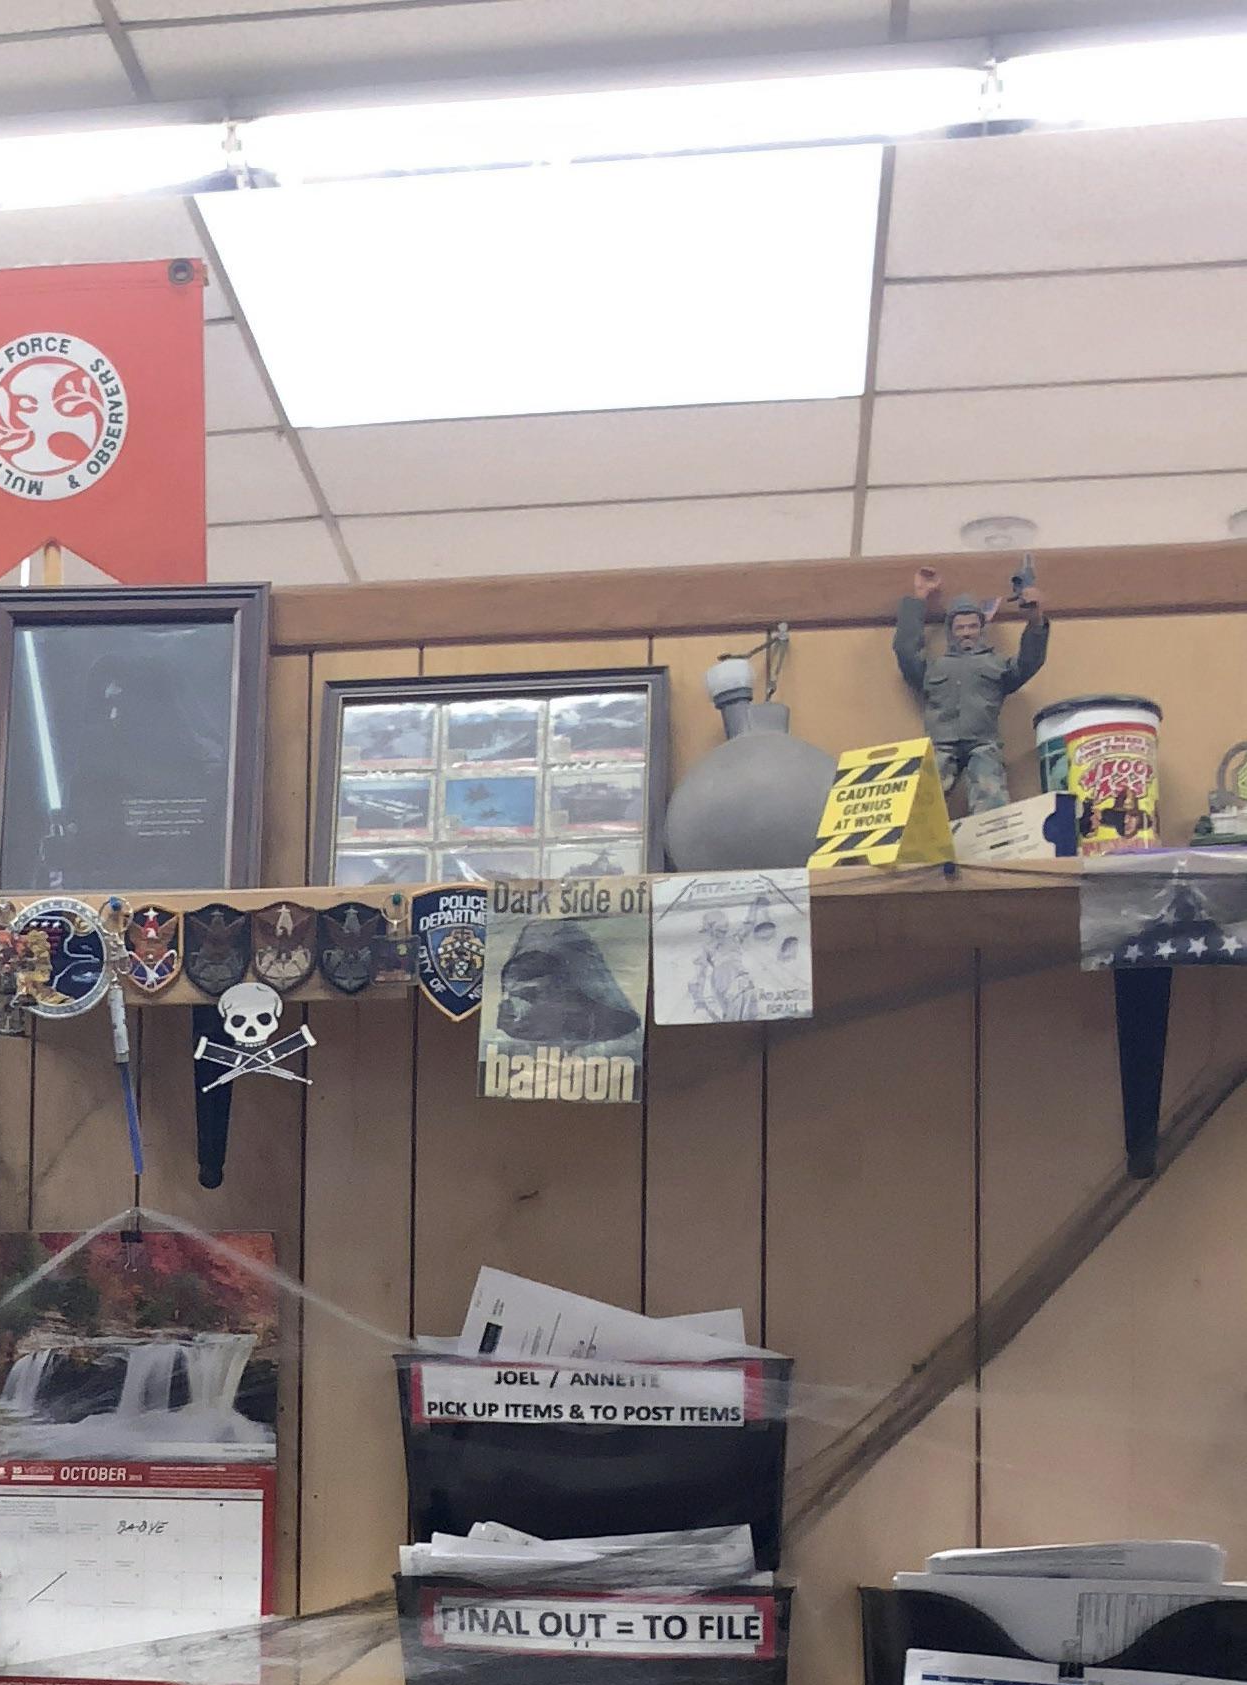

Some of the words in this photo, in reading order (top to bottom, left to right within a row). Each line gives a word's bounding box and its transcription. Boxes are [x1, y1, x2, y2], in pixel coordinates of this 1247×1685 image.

[4, 336, 72, 364] FORCE
[86, 357, 124, 476] OBSERVERS
[836, 780, 908, 802] CAUTION!
[843, 798, 892, 816] GENIUS
[833, 819, 851, 831] AT
[854, 813, 893, 828] WORK
[439, 895, 487, 910] POLICE
[493, 880, 551, 914] Dark
[559, 880, 610, 914] side
[620, 881, 647, 914] of
[419, 909, 487, 931] DEPARTME
[485, 1044, 635, 1101] balloon
[495, 1371, 540, 1386] JOEL
[427, 1401, 467, 1417] PICK
[473, 1402, 499, 1417] UP
[505, 1403, 564, 1420] ITEMS
[569, 1404, 585, 1420] &
[590, 1404, 618, 1420] TO
[623, 1405, 675, 1421] POST
[679, 1406, 742, 1422] ITEMS
[60, 1466, 127, 1482] OCTOBER
[441, 1607, 530, 1636] FINAL
[539, 1611, 607, 1639] OUT
[642, 1614, 688, 1640] TO
[699, 1615, 761, 1641] FILE
